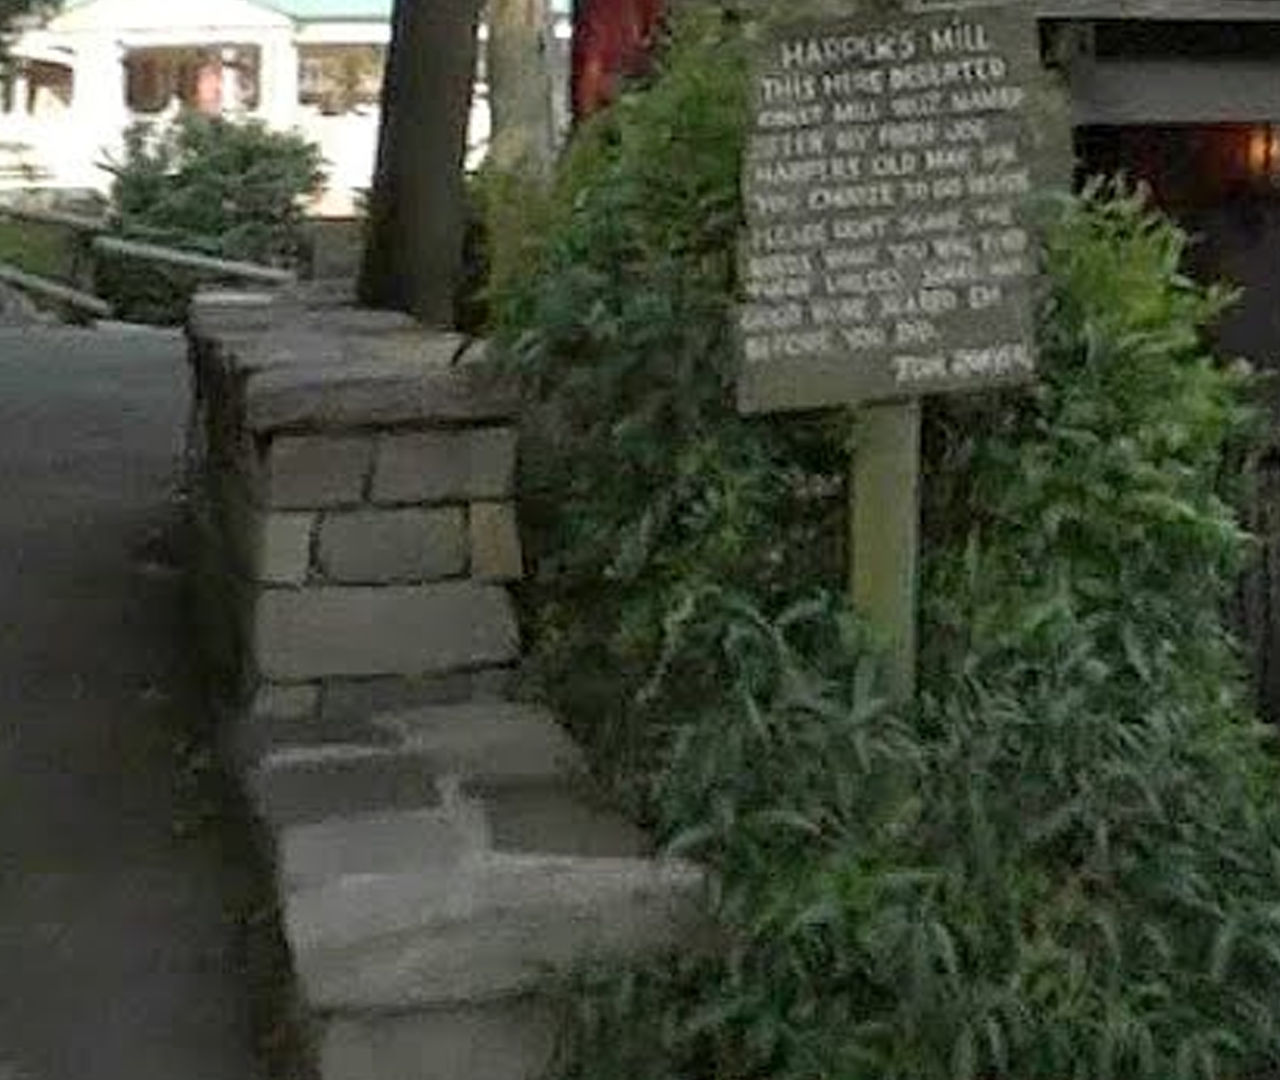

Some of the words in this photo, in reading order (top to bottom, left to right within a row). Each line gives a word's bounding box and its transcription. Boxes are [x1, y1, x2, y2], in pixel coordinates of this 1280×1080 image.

[931, 22, 989, 53] MILL
[761, 71, 816, 102] THIS
[833, 98, 880, 121] MILL
[871, 150, 918, 176] OLD
